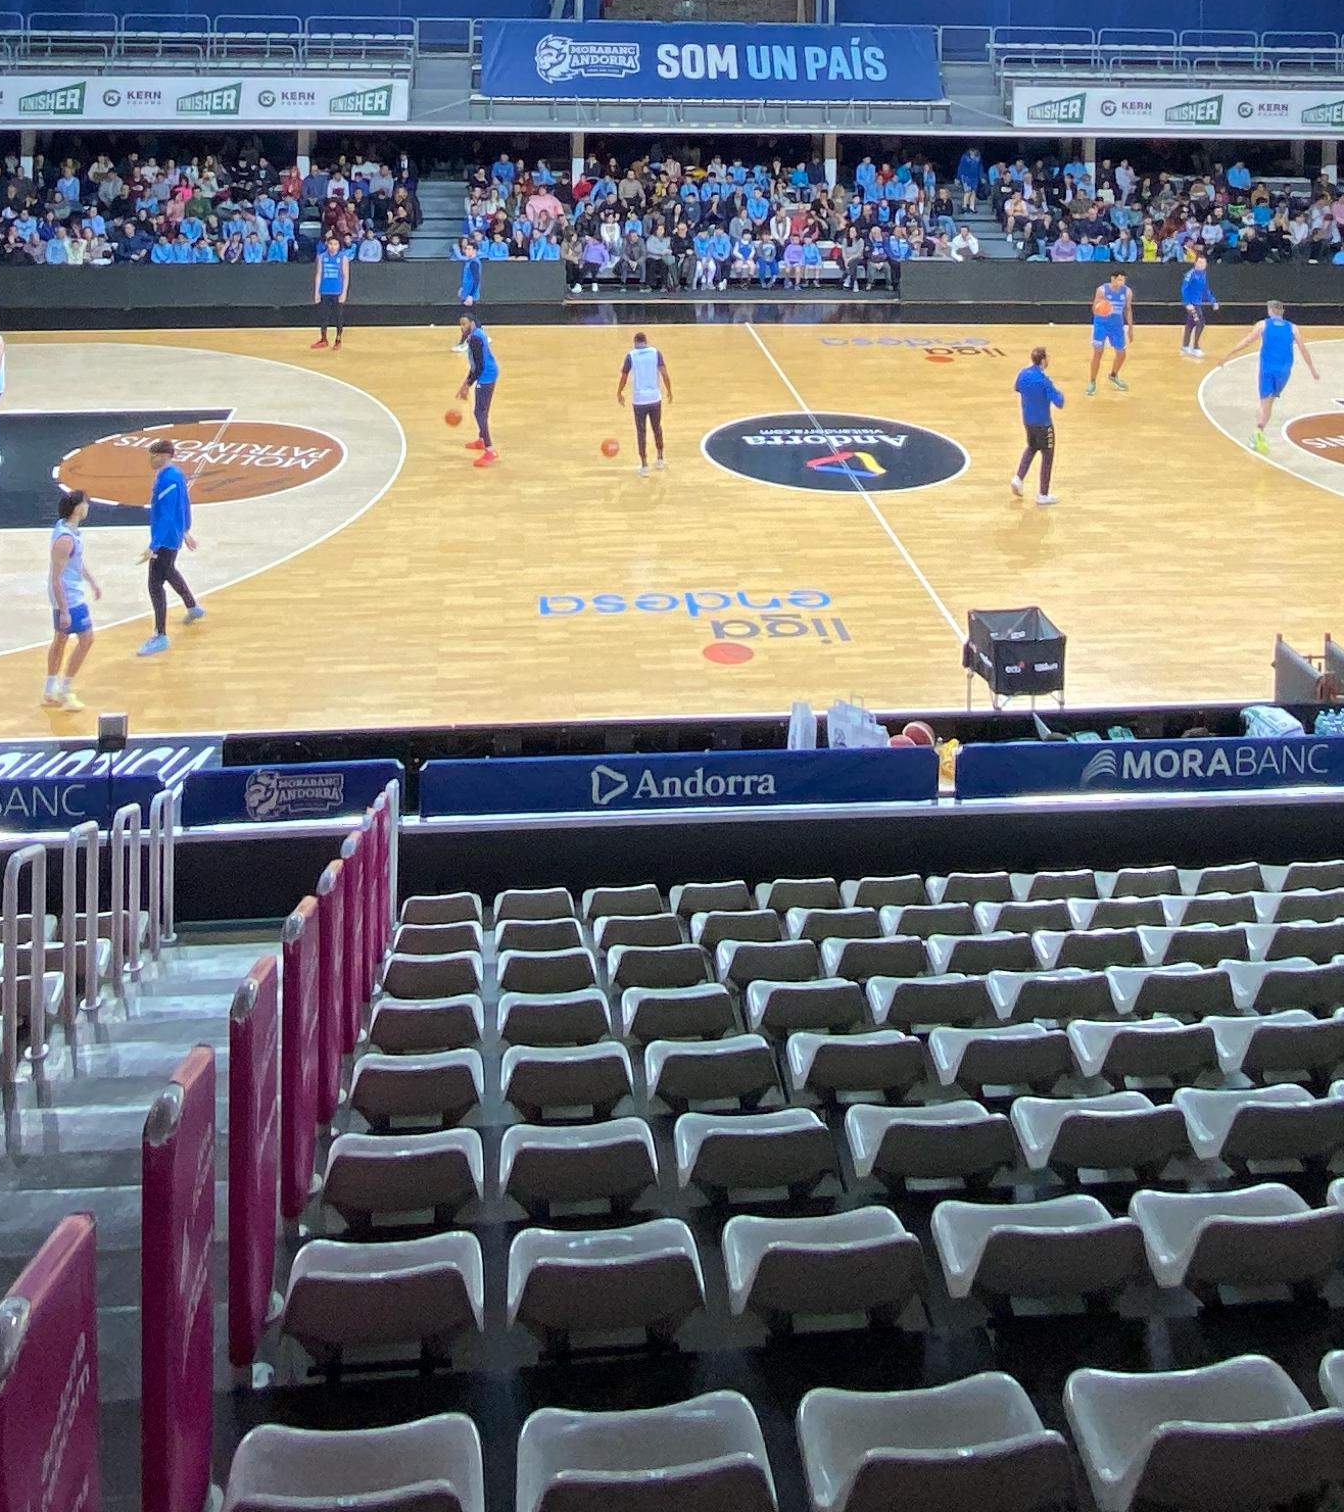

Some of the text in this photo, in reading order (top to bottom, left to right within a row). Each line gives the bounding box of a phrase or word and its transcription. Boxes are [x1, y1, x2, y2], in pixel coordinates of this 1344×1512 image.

[570, 54, 637, 69] ANDORRA
[657, 36, 887, 82] SOM UN PAÍS
[126, 90, 162, 100] KERN
[281, 91, 316, 101] KERN
[1121, 101, 1152, 111] KERN
[1258, 103, 1289, 113] KERN
[742, 434, 909, 448] Andorra
[537, 589, 831, 618] endesa
[710, 614, 852, 644] liga
[633, 767, 776, 800] Andorra
[278, 787, 341, 802] ANDORRA
